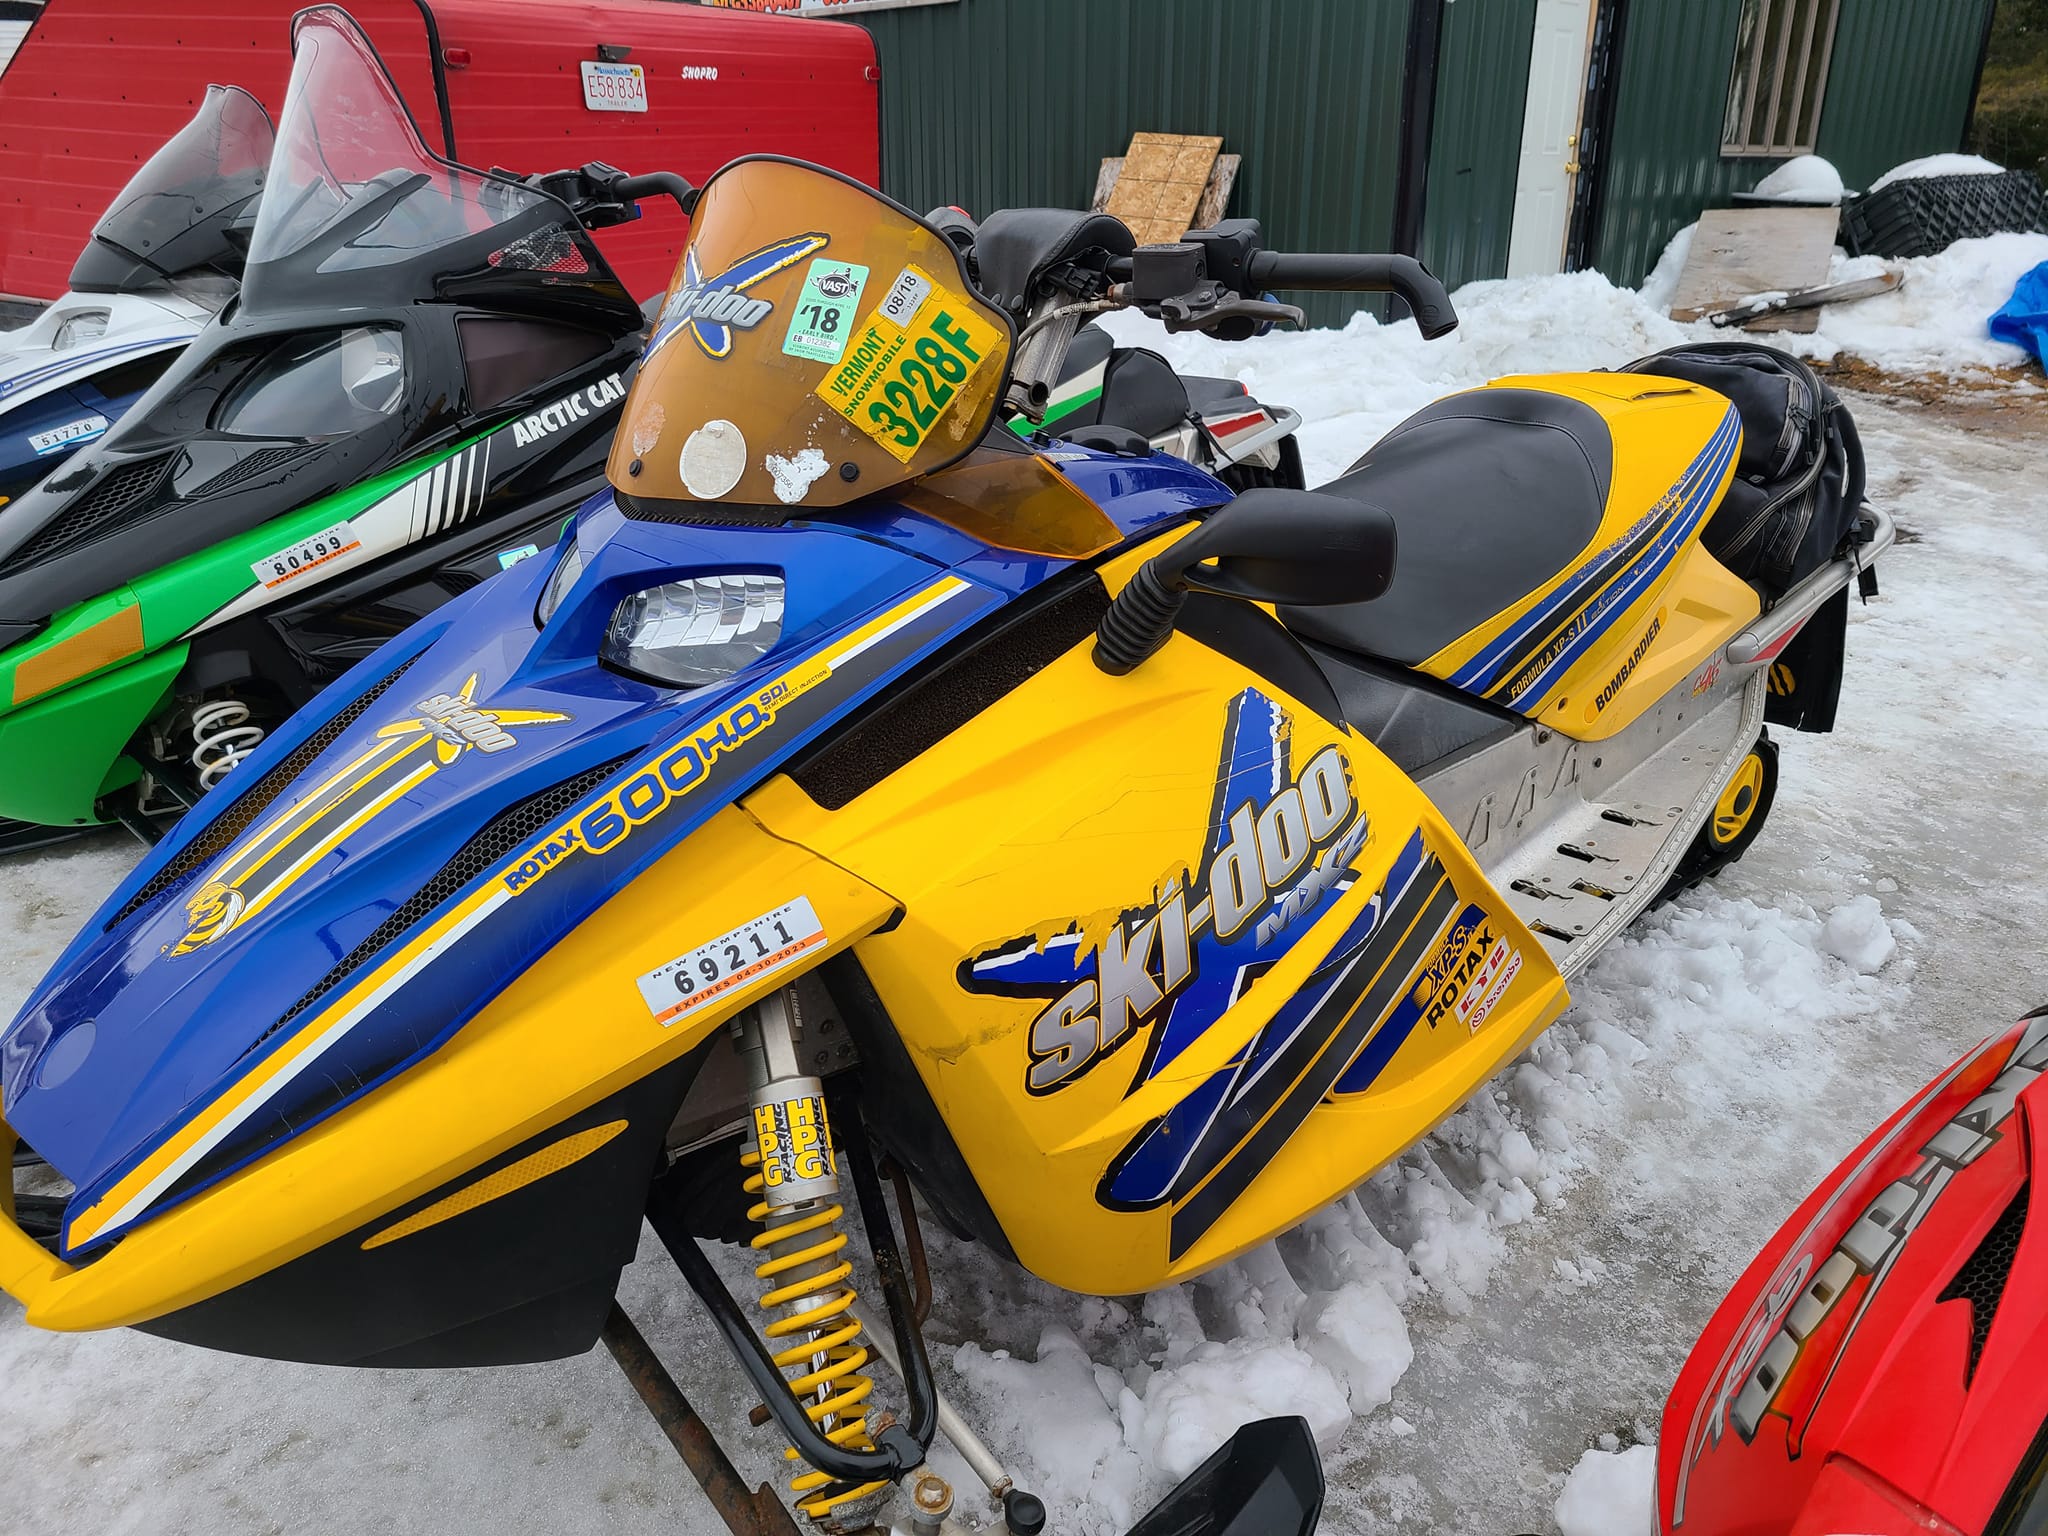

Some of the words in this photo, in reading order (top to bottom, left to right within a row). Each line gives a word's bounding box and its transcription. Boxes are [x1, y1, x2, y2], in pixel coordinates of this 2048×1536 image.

[821, 279, 847, 293] VAST
[887, 276, 917, 315] 08/18
[830, 327, 886, 397] VERMONT
[844, 334, 907, 417] SNOWMOBILE
[868, 310, 981, 447] 3228F
[41, 423, 92, 446] 51770
[512, 394, 589, 448] ARCTIC
[587, 372, 626, 408] CAT
[273, 536, 341, 576] 80499
[759, 681, 788, 706] SDI
[800, 669, 827, 689] INJECTION
[1511, 651, 1553, 699] FORMULA
[1553, 628, 1576, 658] XP-S
[1595, 617, 1661, 712] BOMBARDIER
[503, 829, 581, 890] ROTAX
[579, 745, 702, 850] 600
[1256, 811, 1368, 950] MXZ
[653, 958, 687, 979] NEW
[697, 906, 793, 957] HAMPSHIRE
[673, 920, 795, 995] 69211
[675, 980, 730, 1013] EXPIRES
[736, 942, 807, 981] 04-30-2023
[1426, 925, 1494, 1029] ROTAX
